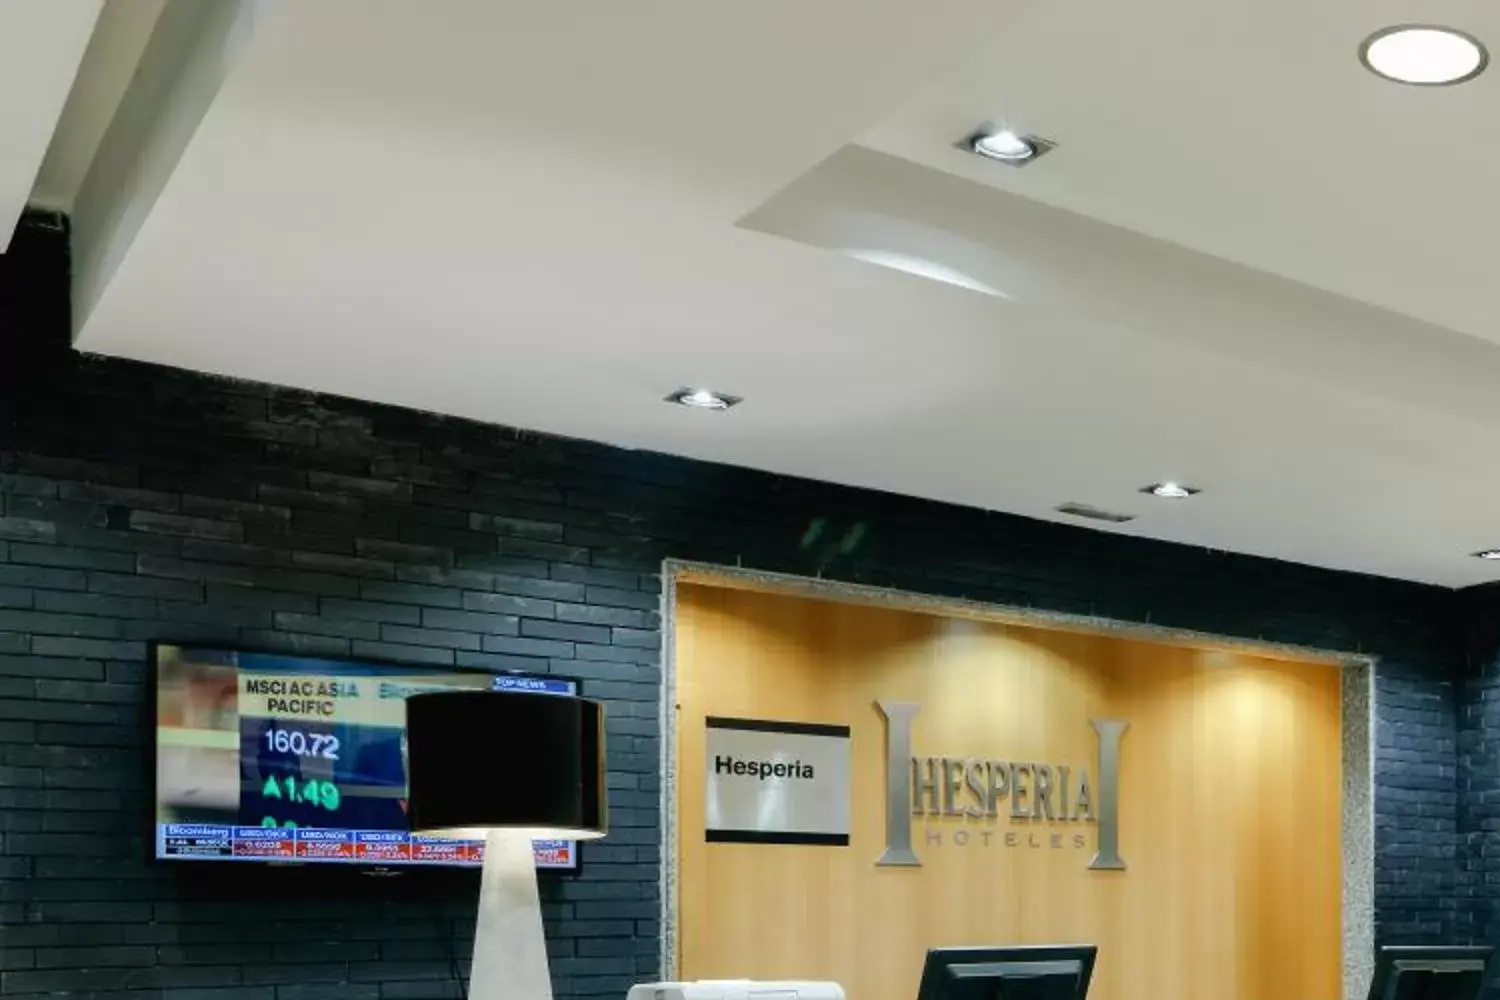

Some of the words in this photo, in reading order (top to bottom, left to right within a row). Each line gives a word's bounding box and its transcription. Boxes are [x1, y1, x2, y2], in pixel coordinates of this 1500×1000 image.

[246, 680, 285, 696] MSCI
[289, 681, 315, 696] AC
[317, 682, 359, 698] ASIA
[267, 698, 334, 716] PACIFIC
[265, 729, 340, 761] 160.72
[715, 755, 814, 780] Hesperia
[911, 757, 1097, 822] HESPERIA
[926, 829, 1086, 850] HOTELES
